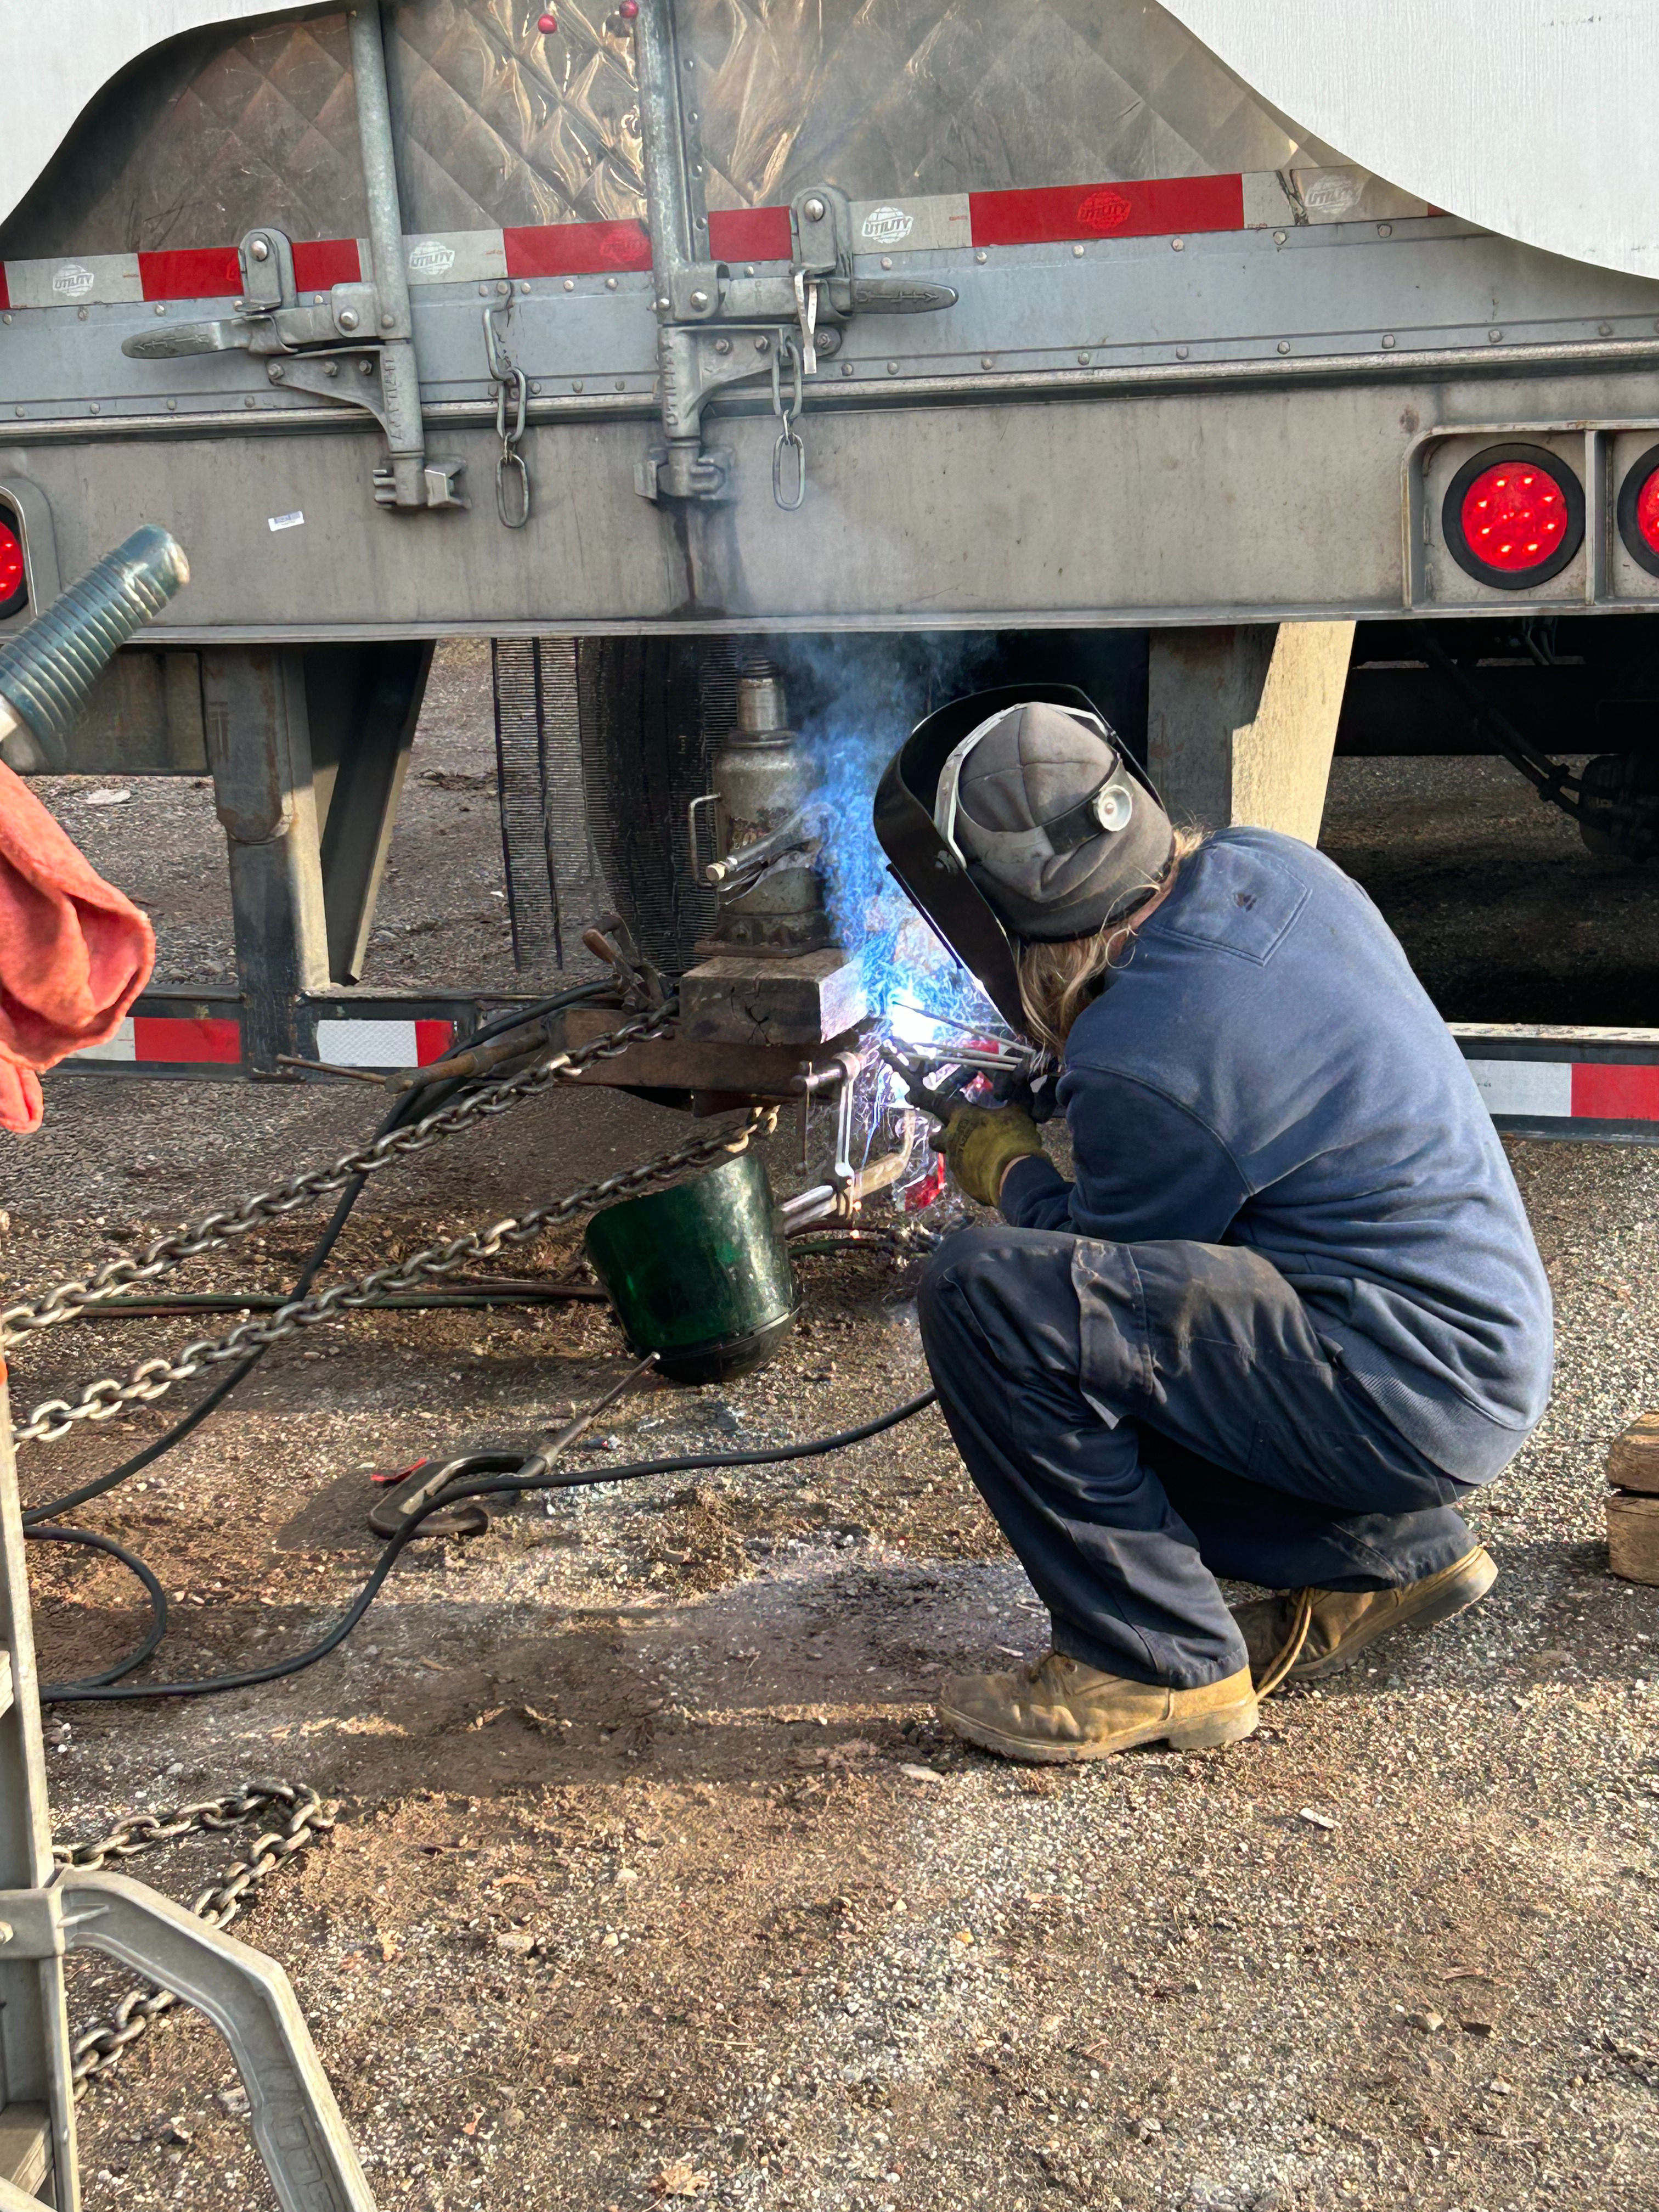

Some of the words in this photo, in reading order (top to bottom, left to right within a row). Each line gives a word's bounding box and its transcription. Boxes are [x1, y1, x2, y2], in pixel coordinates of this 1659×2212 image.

[865, 218, 911, 235] UTILITY
[411, 251, 454, 267] UTILITY
[55, 274, 92, 289] UTILITY
